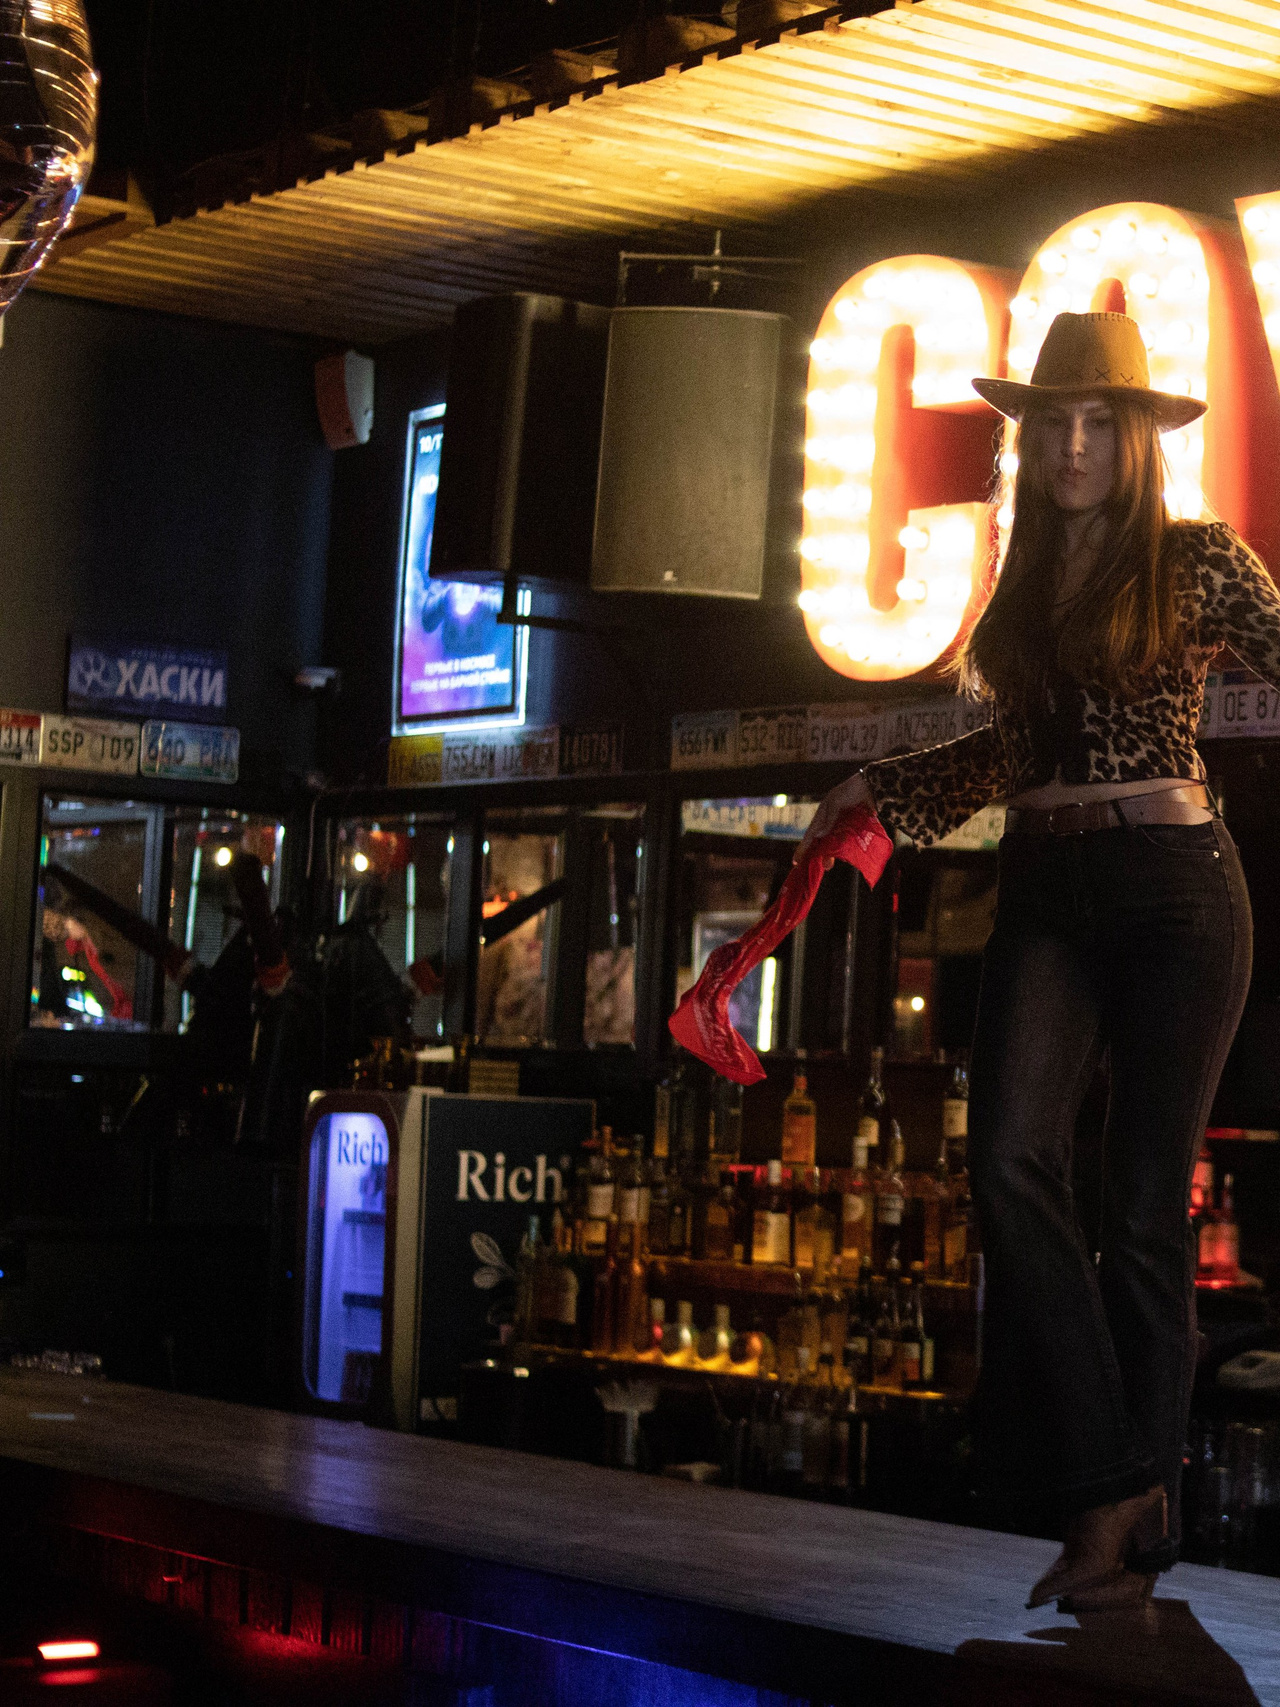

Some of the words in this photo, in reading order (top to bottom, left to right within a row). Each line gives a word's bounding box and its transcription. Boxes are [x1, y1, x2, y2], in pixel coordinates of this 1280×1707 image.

[116, 659, 225, 708] ХАСКИ
[49, 729, 84, 755] SSP
[99, 733, 135, 761] 109
[336, 1130, 383, 1166] Rich
[455, 1149, 563, 1203] Rich
